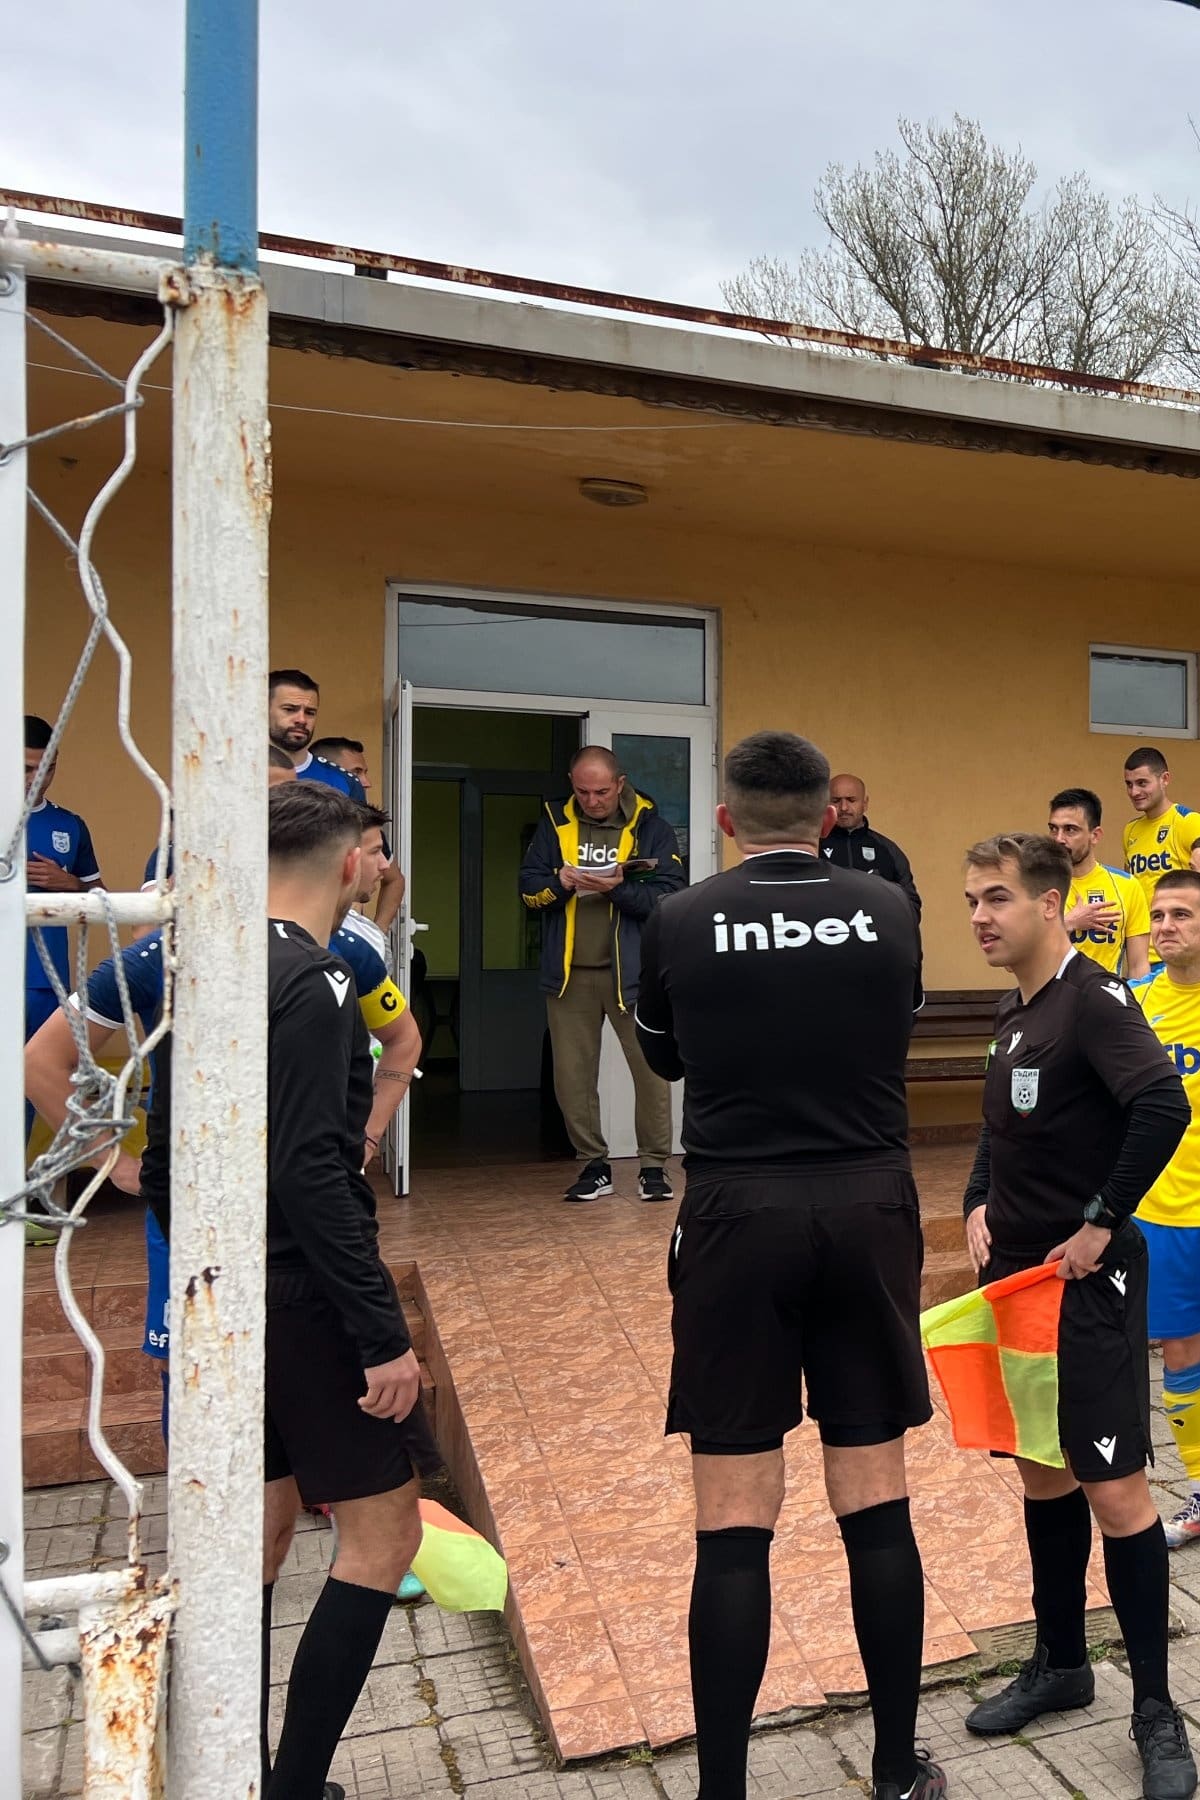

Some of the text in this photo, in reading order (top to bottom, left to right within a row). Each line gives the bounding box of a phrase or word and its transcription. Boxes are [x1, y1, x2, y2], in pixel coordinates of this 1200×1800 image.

[578, 842, 619, 863] dida
[1129, 850, 1173, 875] fbet
[712, 909, 879, 953] inbet
[380, 991, 398, 1012] C
